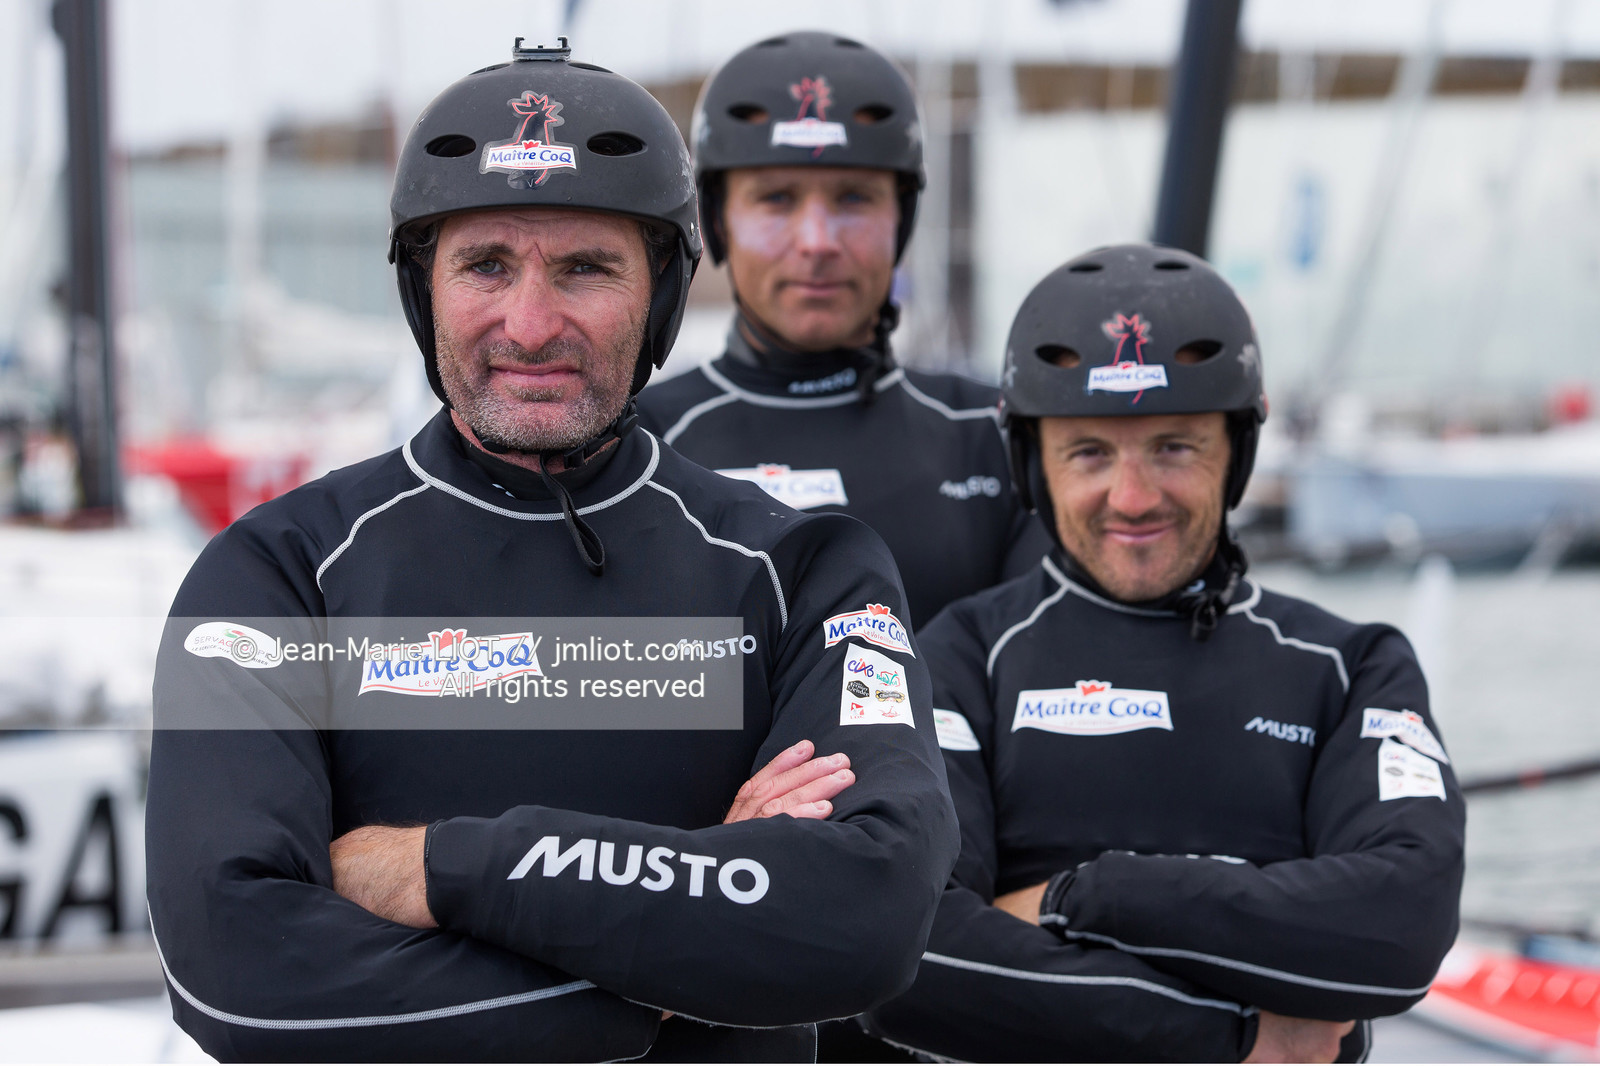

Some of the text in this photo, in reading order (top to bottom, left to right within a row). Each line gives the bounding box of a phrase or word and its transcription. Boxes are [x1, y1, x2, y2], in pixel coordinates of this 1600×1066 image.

[829, 616, 886, 639] Maître
[1108, 697, 1163, 718] CoQ
[506, 836, 770, 905] MUSTO
